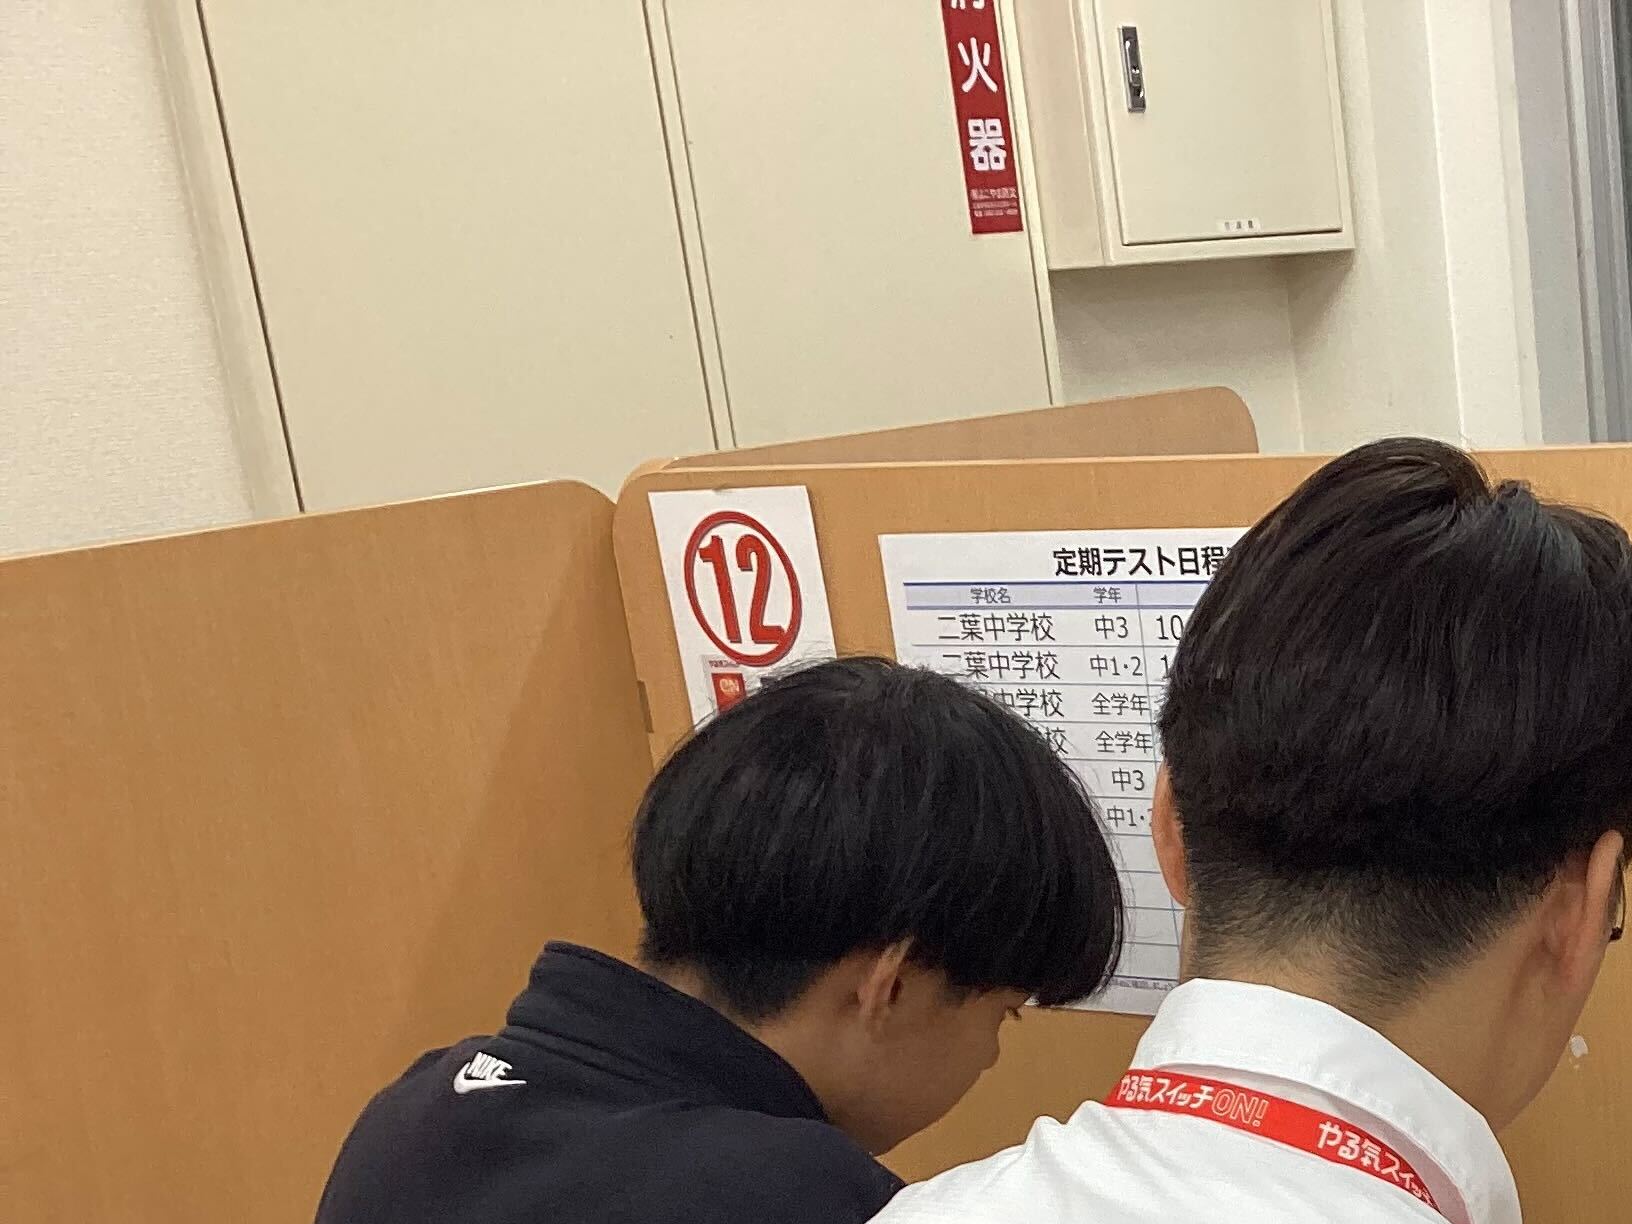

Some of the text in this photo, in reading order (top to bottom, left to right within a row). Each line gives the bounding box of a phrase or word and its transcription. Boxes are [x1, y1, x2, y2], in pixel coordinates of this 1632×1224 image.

[951, 0, 1007, 171] 火器
[1053, 546, 1230, 576] 定期テスト日程
[699, 535, 788, 644] 12
[970, 587, 1011, 604] 学校名
[1093, 586, 1122, 603] 学年
[938, 612, 1056, 641] 二葉中学校
[1094, 614, 1129, 639] 中3
[942, 651, 1060, 680] 二葉中学校
[979, 688, 1065, 717] 中学校
[1091, 692, 1150, 716] 全学年
[1095, 730, 1153, 753] 全学年
[1111, 767, 1145, 792] 中3
[1106, 804, 1153, 828] 中1・
[467, 1051, 513, 1081] NIKE
